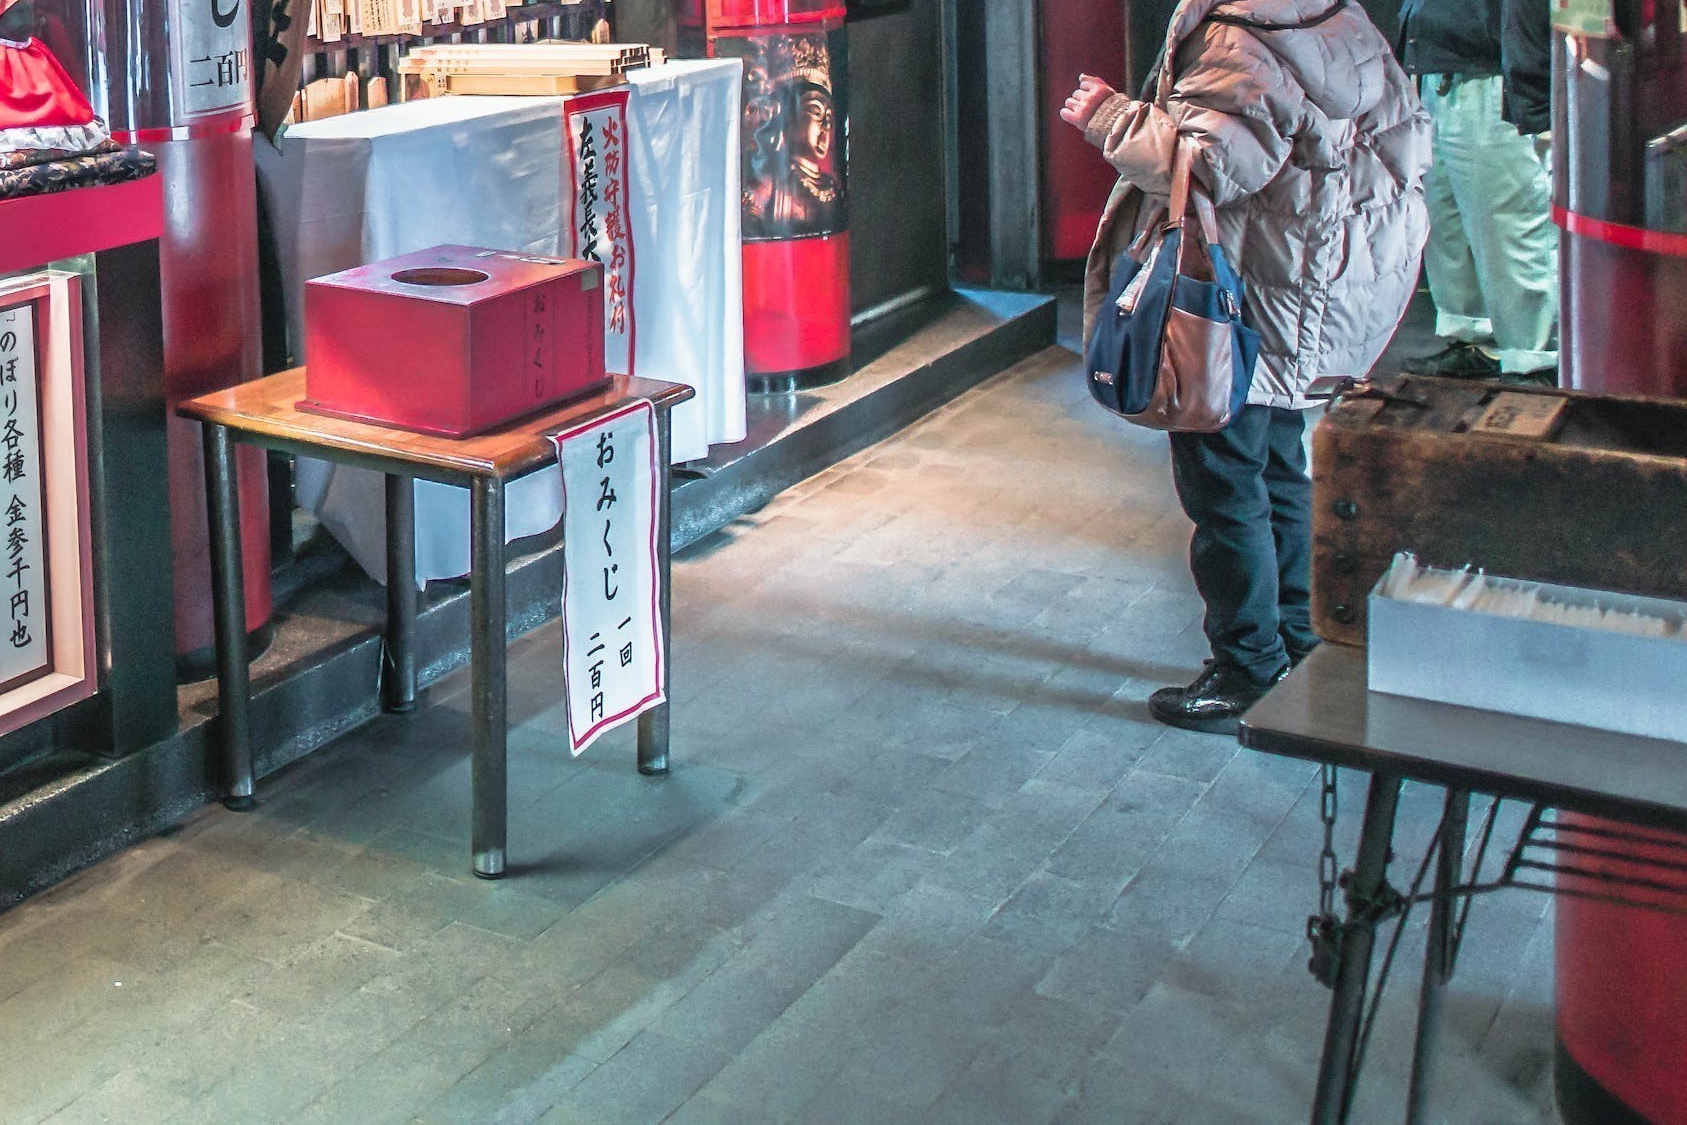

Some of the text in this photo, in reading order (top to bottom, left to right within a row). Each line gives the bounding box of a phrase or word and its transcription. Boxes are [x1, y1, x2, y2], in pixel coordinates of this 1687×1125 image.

[593, 430, 620, 604] おみくじ
[585, 630, 605, 720] 二百円
